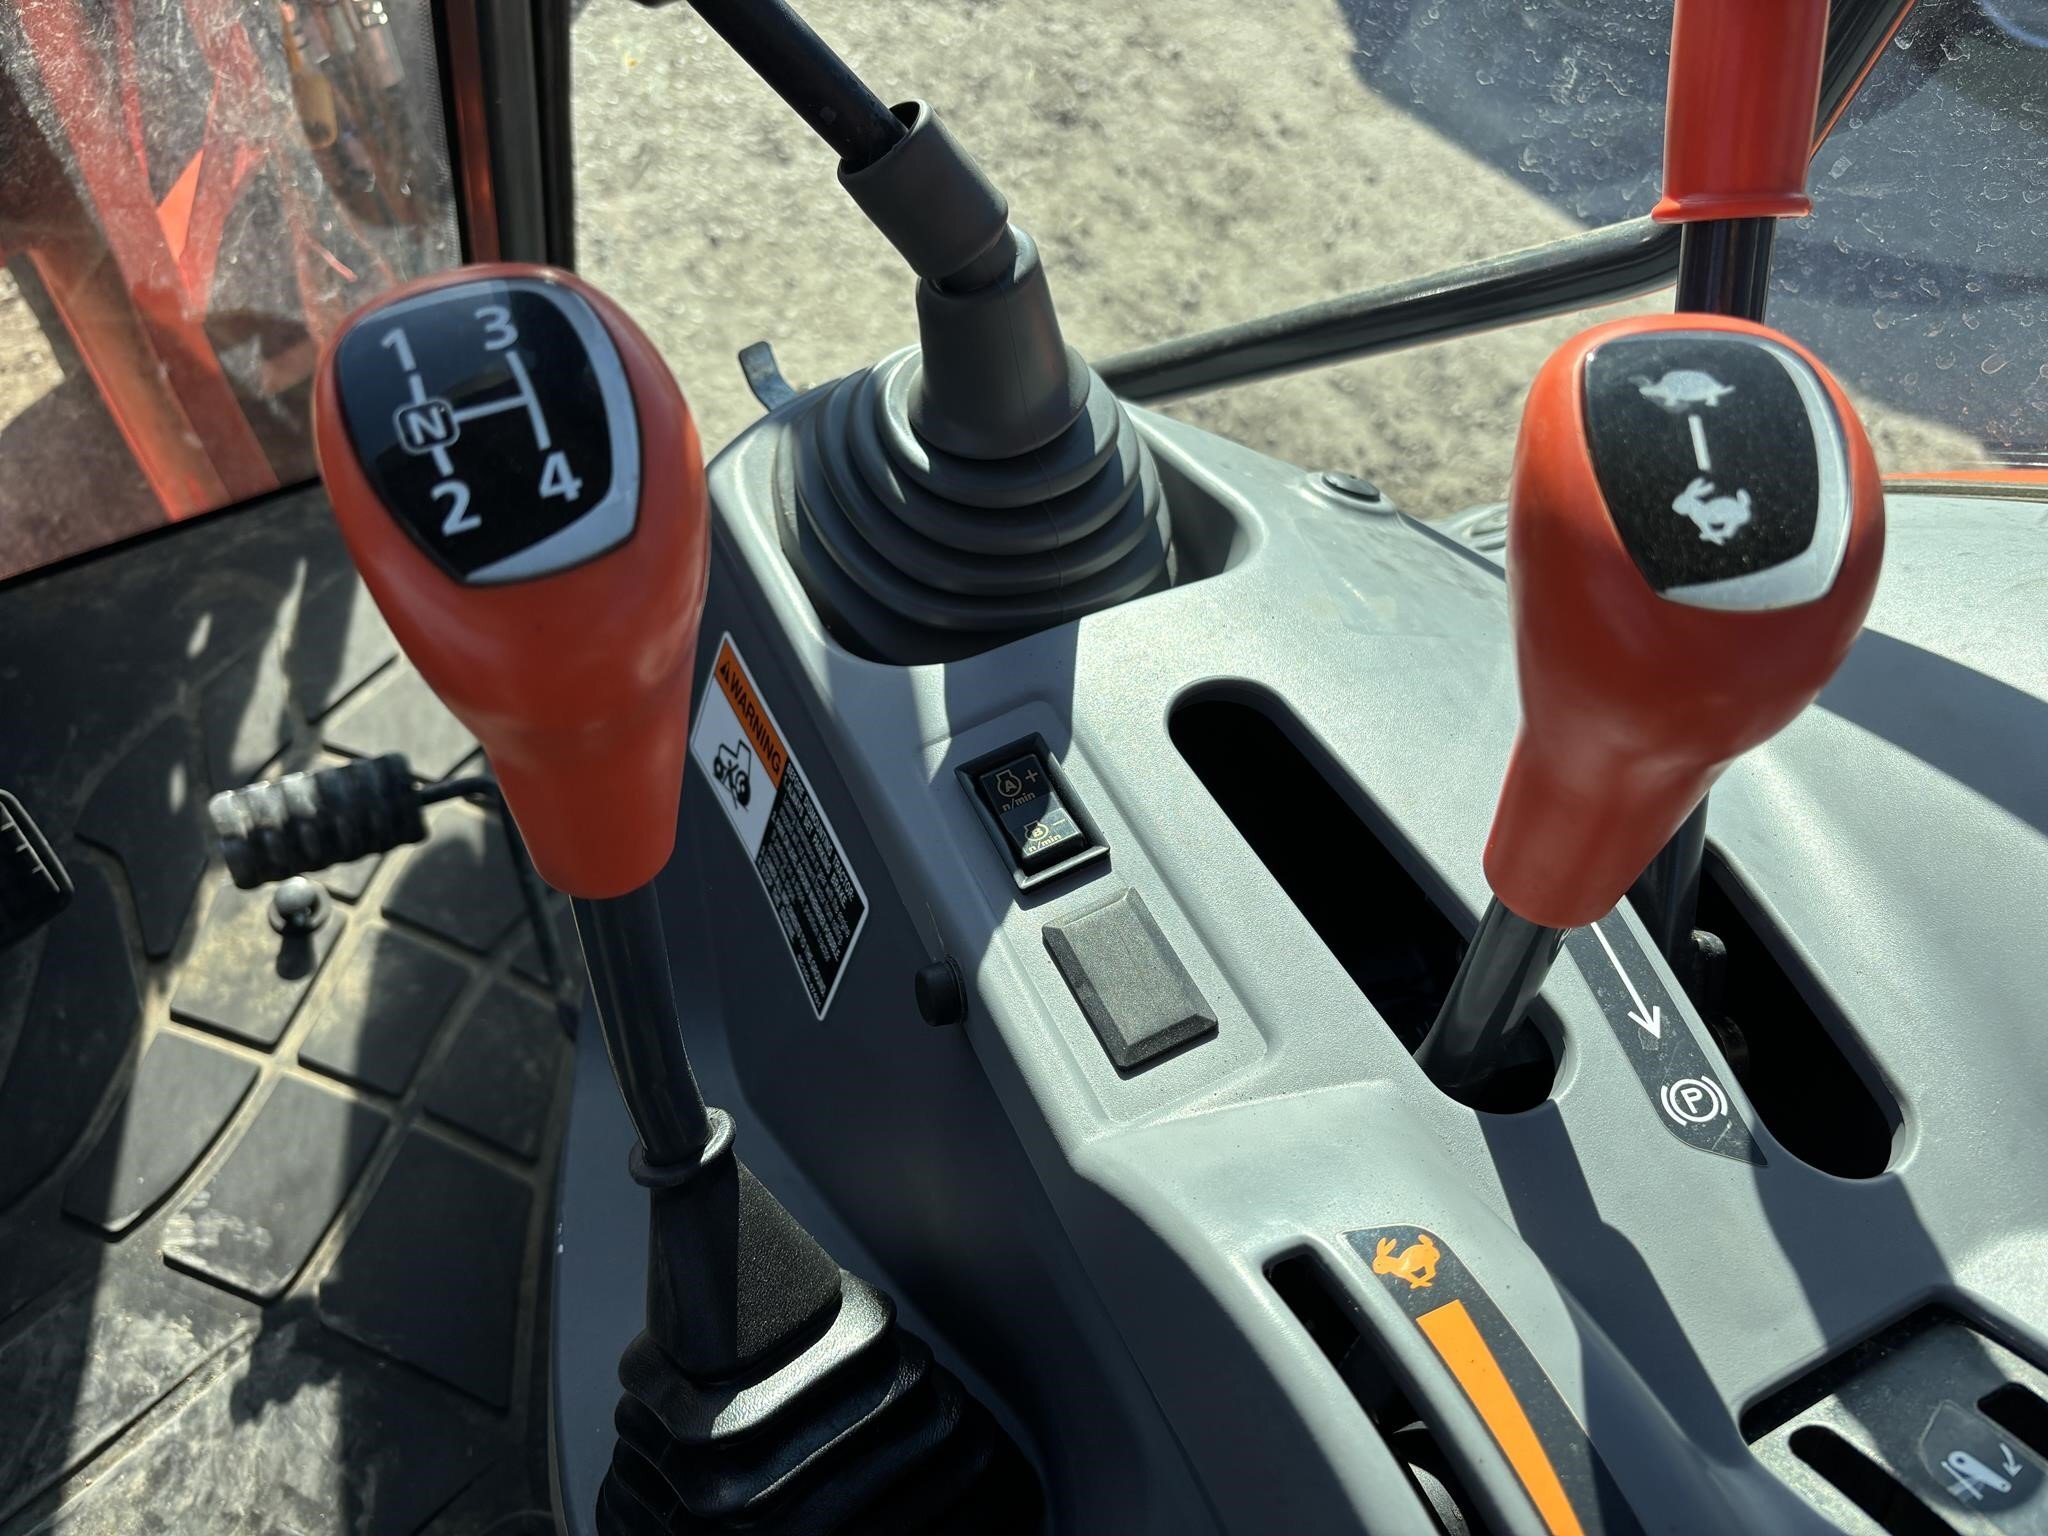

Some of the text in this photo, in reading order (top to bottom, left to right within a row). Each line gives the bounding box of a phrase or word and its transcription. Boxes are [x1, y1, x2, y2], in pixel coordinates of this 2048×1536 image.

[381, 306, 518, 372] 1 3
[407, 406, 447, 447] N
[431, 452, 583, 537] 2 4
[729, 672, 782, 775] WARNING
[1002, 791, 1036, 811] n/min
[1028, 834, 1062, 852] n/min
[1680, 1087, 1703, 1114] P
